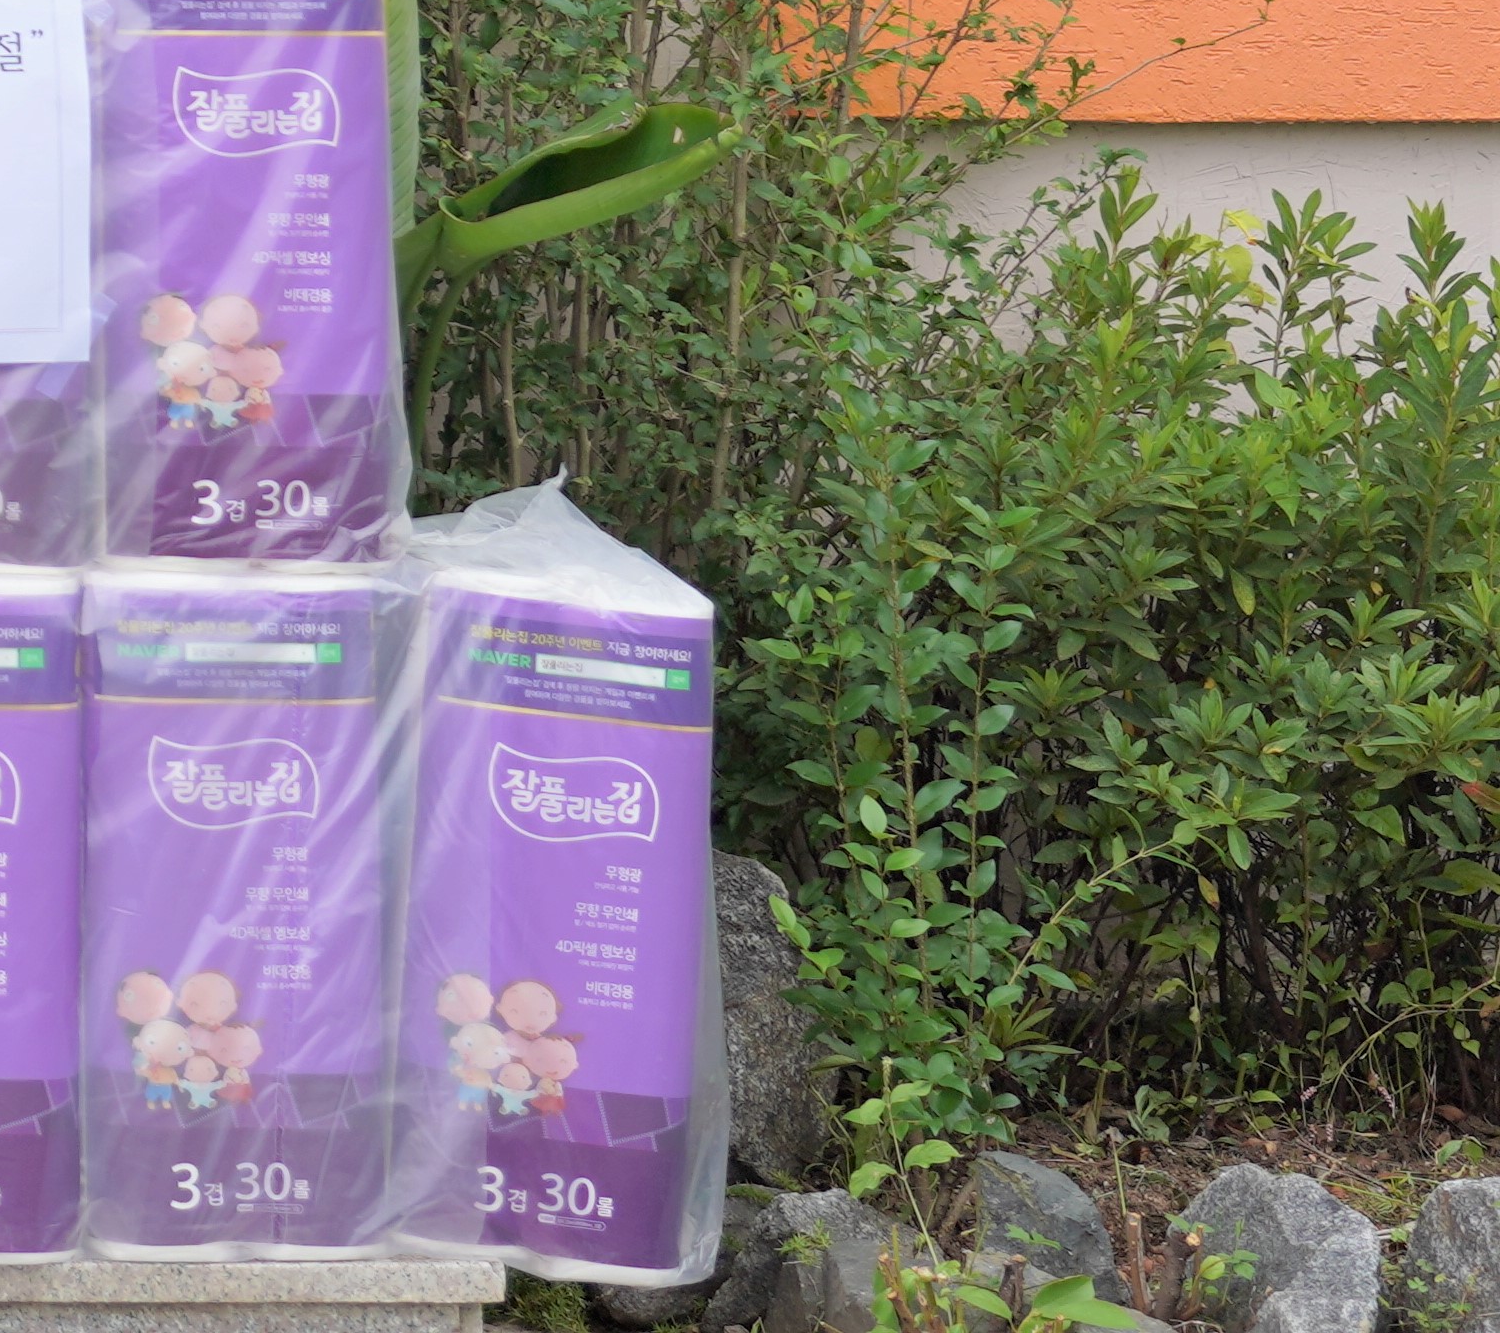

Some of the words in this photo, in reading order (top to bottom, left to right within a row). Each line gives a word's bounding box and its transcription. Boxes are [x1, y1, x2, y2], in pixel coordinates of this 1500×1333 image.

[186, 89, 323, 135] 잘풀리는집
[468, 649, 532, 668] NAVER
[607, 641, 630, 655] 지금
[162, 759, 301, 808] 잘풀리는집
[501, 772, 643, 825] 잘풀리는집
